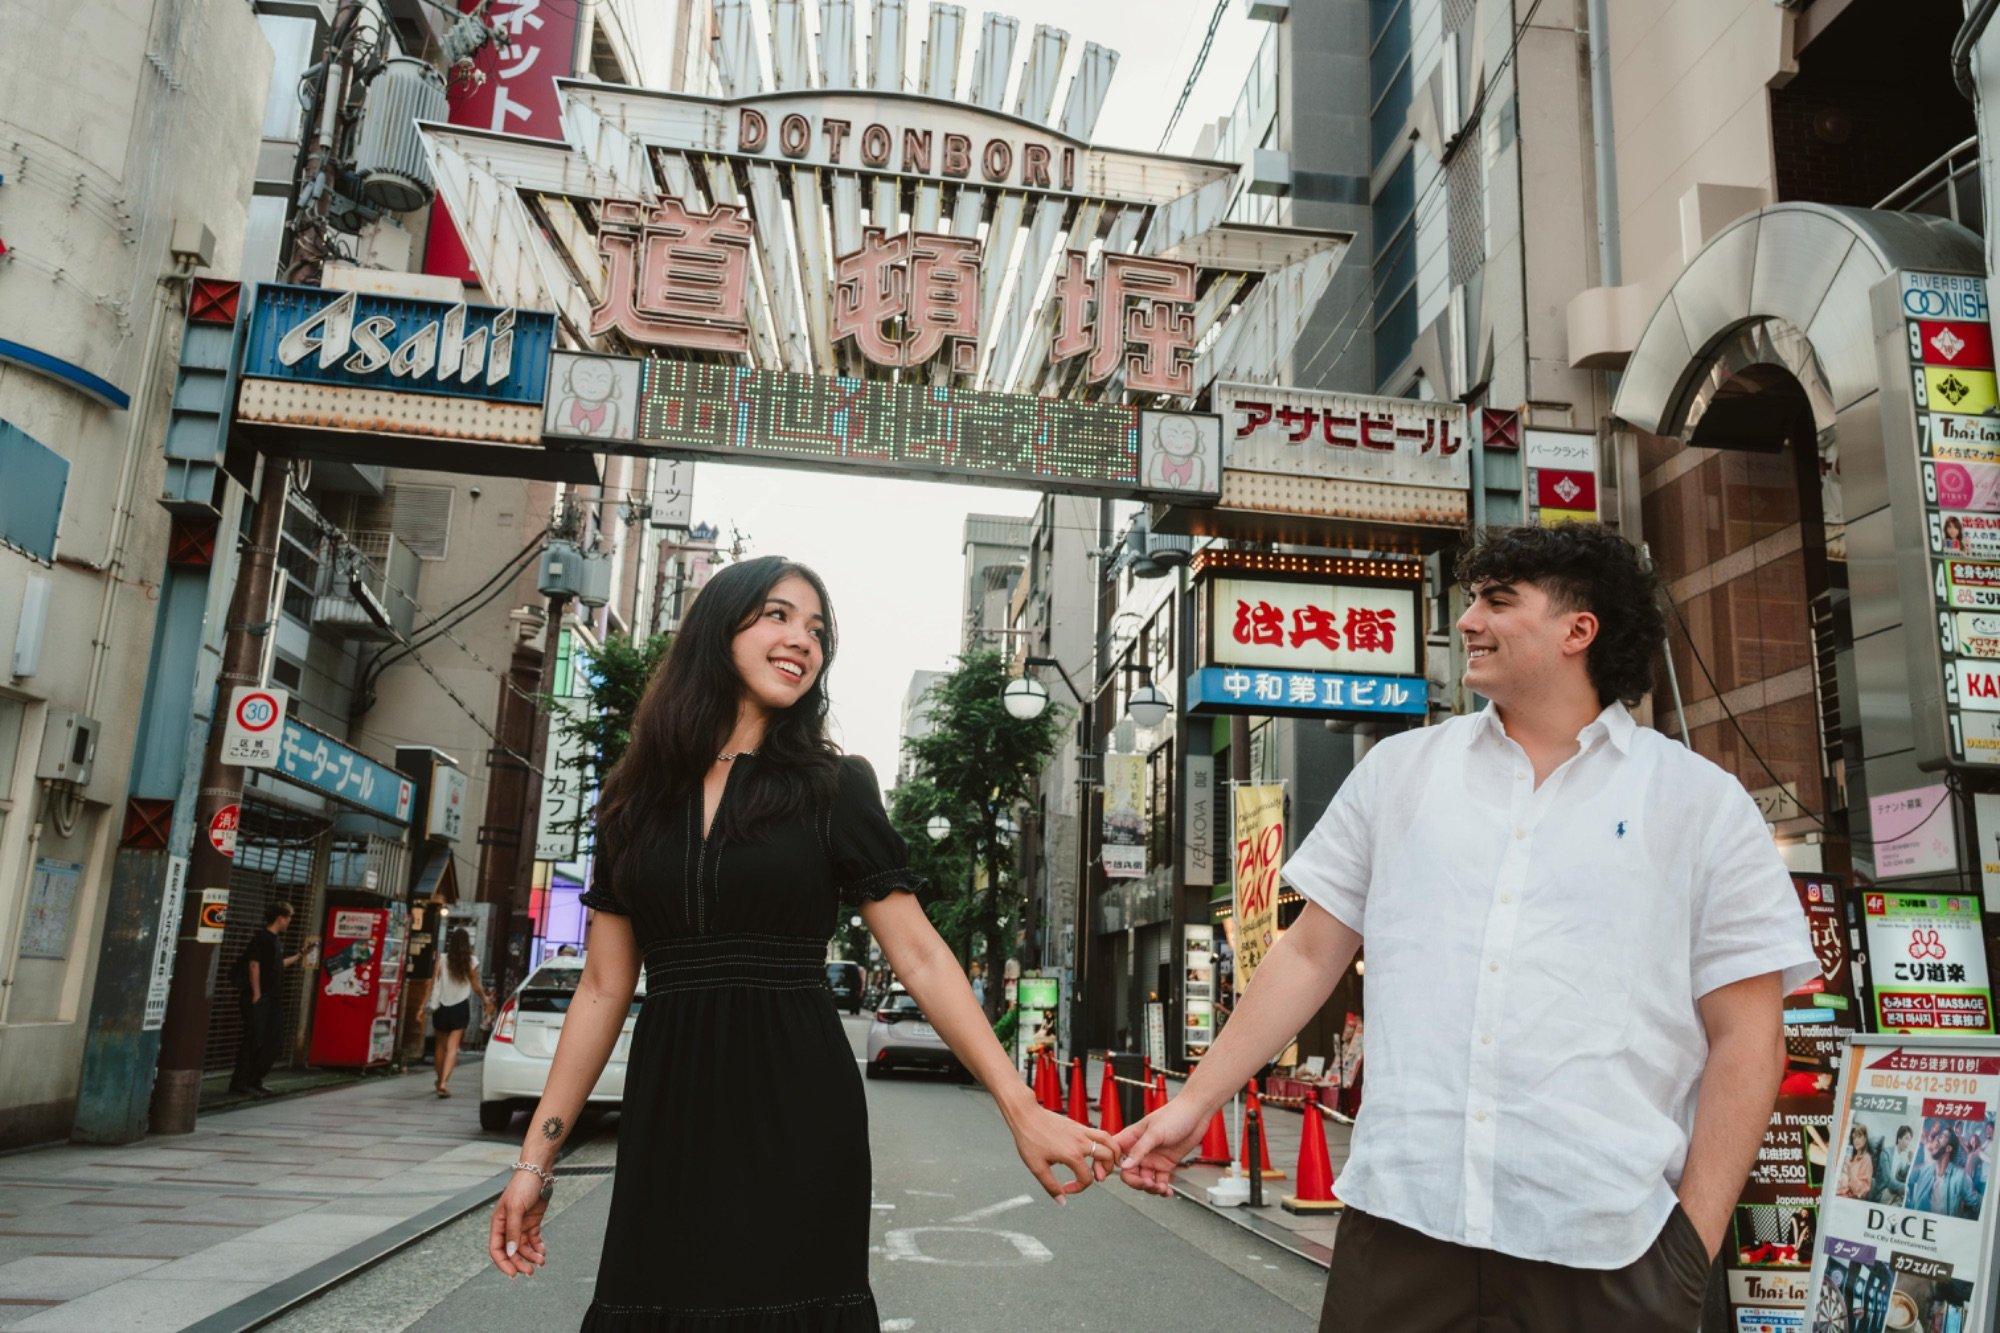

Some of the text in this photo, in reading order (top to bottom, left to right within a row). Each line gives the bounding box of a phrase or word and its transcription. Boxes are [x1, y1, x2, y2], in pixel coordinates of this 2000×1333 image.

[738, 106, 1075, 191] DOTONBORI
[590, 194, 1197, 397] 道頓堀
[1910, 274, 1982, 292] RIVERSIDE
[278, 290, 517, 386] Asahi
[1909, 322, 1923, 359] 9
[1914, 370, 1929, 406] 8
[645, 359, 1136, 481] 出世地蔵尊
[1234, 400, 1463, 456] アサヒビール
[1919, 416, 1931, 453] 7
[1924, 463, 1937, 502] 6
[1929, 513, 1942, 552] 5
[1935, 562, 1947, 603] 4
[1939, 612, 1953, 653] 3
[1945, 662, 1960, 703] 2
[245, 703, 270, 721] 30
[230, 746, 270, 759] ここから
[1950, 714, 1962, 755] 1
[282, 726, 375, 800] モータープール
[1238, 823, 1283, 879] TAKO
[1240, 868, 1277, 919] YAKI
[1894, 963, 1967, 982] こり道楽
[1937, 998, 1984, 1010] MASSAGE
[1891, 1057, 1980, 1073] ここから徒歩10秒!
[1886, 1074, 1978, 1095] 06-6212-5910
[1854, 1096, 1903, 1112] ネットカフェ
[1934, 1102, 1974, 1117] カラオケ
[1761, 1165, 1806, 1178] ¥5,500
[1775, 1195, 1814, 1206] Japanese
[1834, 1241, 1860, 1258] ダーツ
[1895, 1256, 1948, 1277] カフェ&バー
